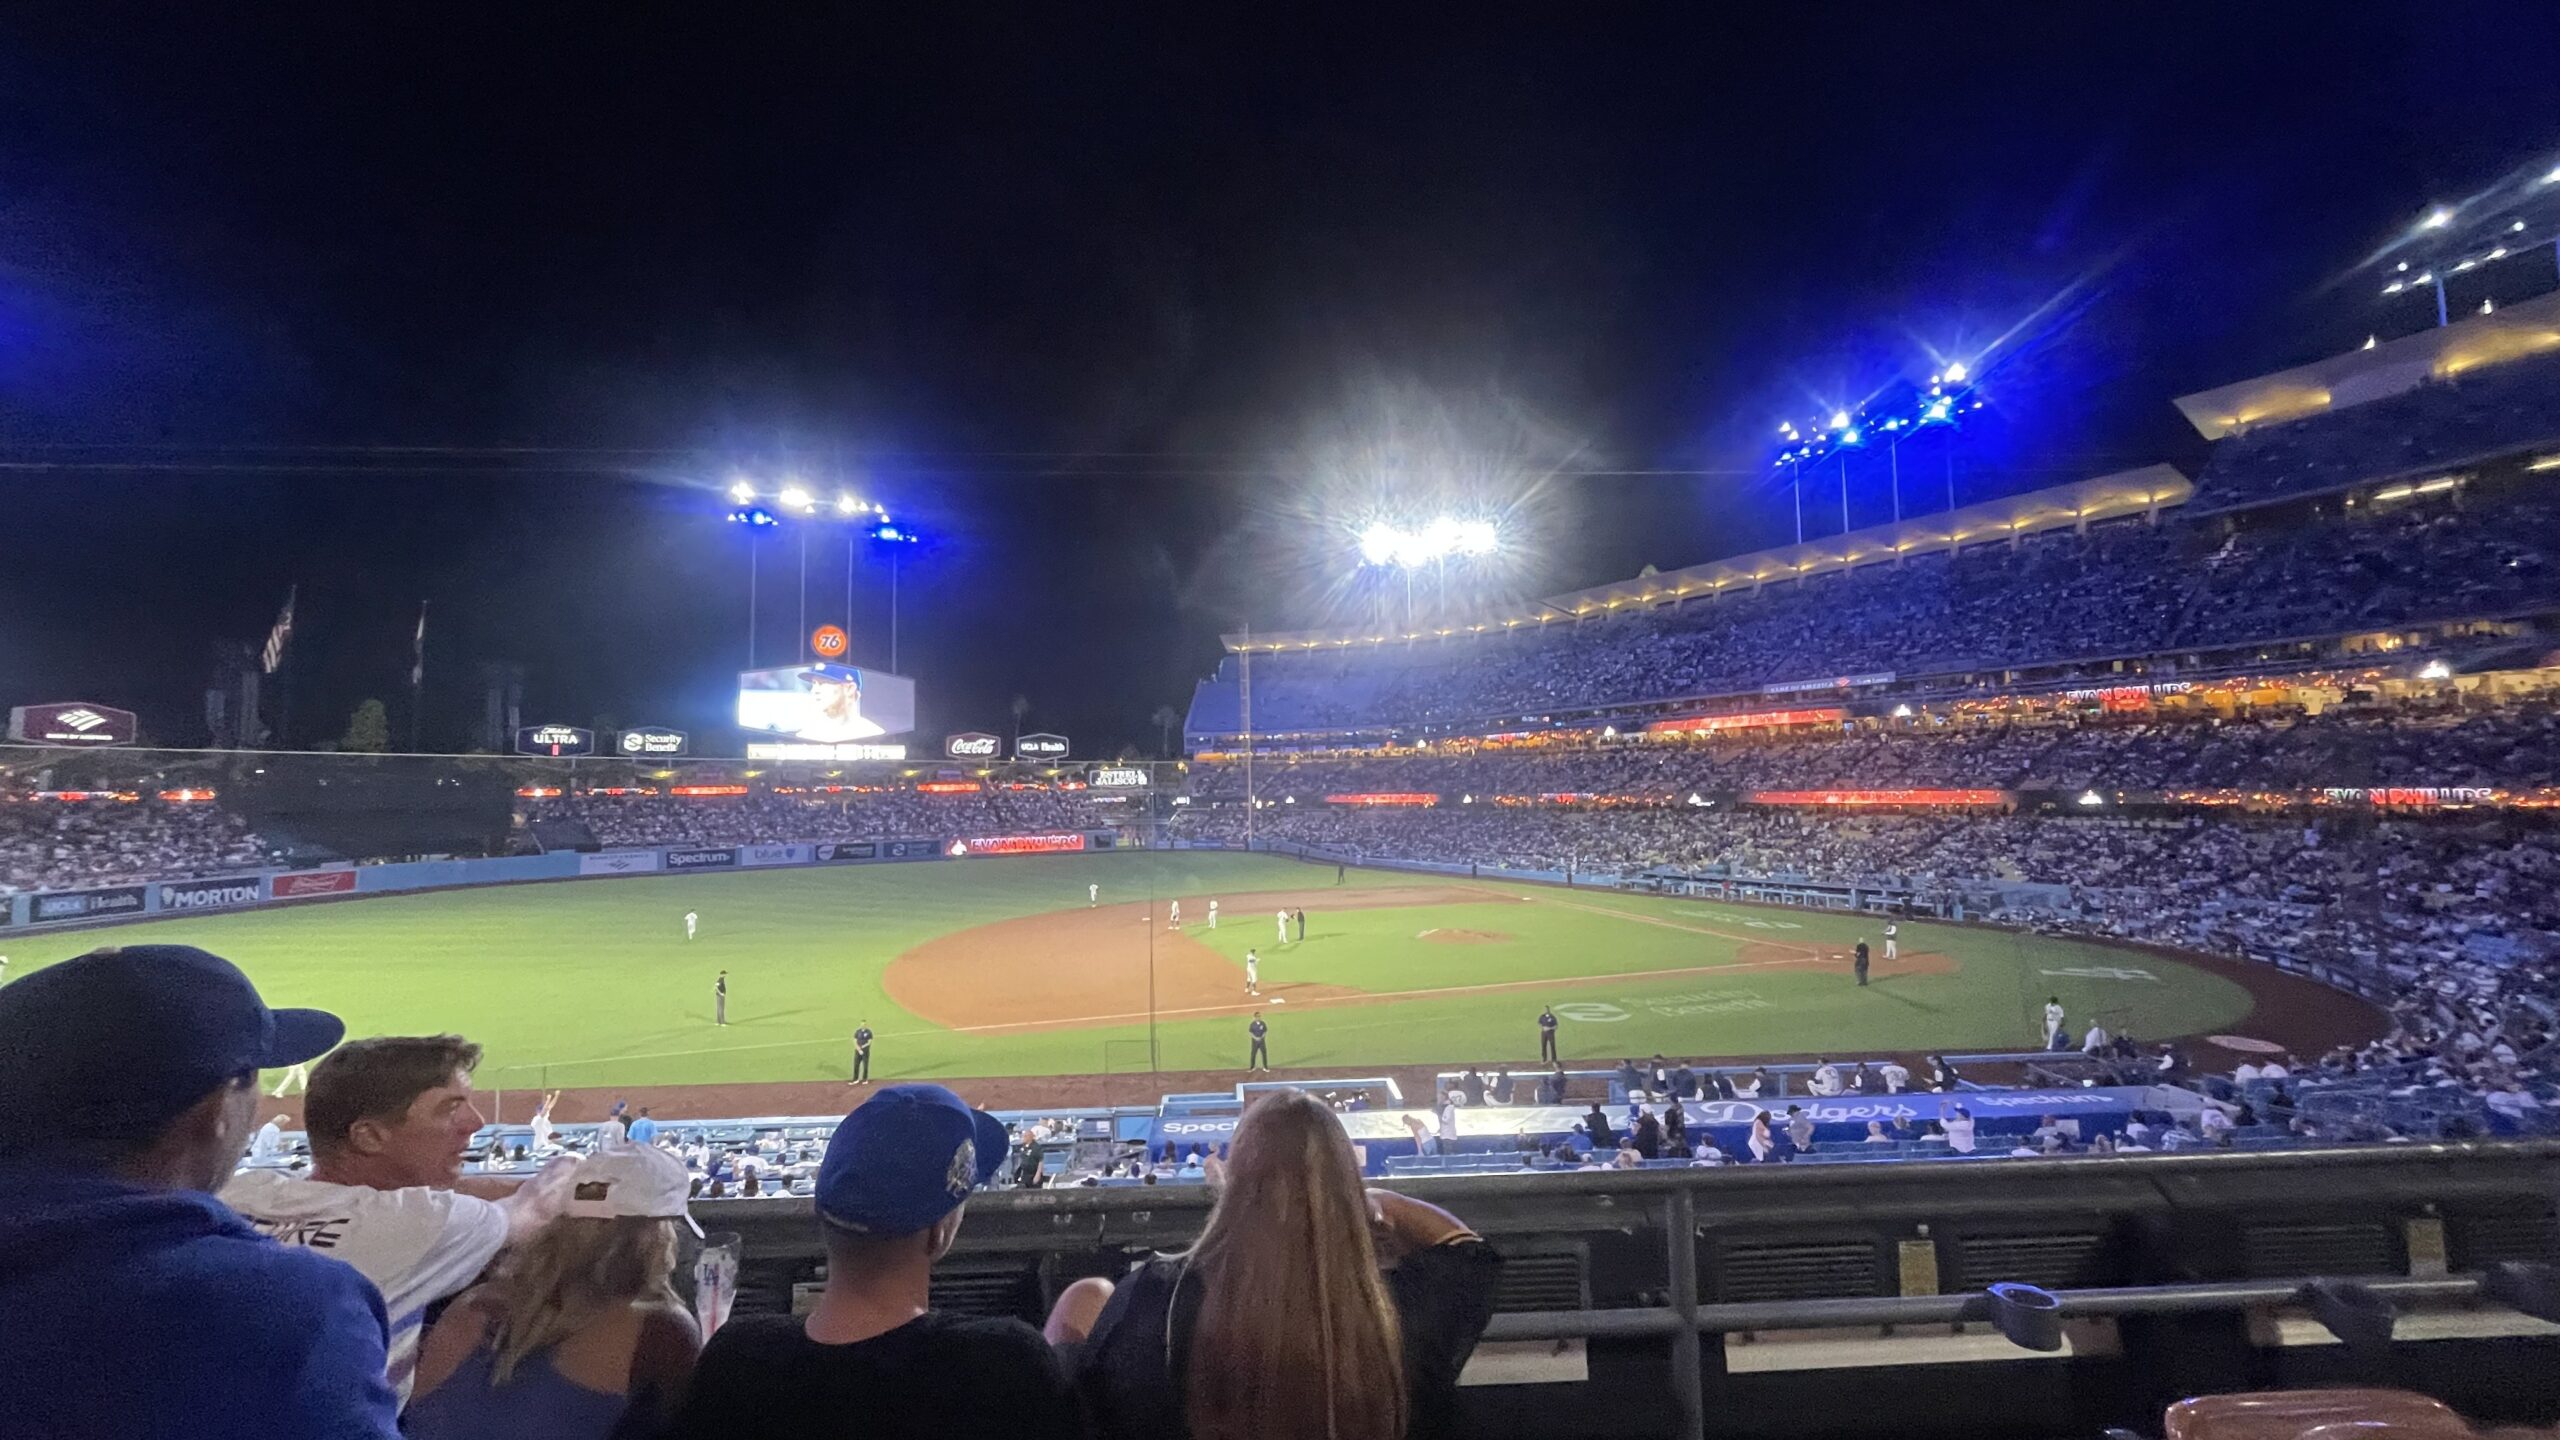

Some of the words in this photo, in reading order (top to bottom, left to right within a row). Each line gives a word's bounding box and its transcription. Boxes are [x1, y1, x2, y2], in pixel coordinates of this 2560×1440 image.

[821, 635, 841, 649] 76
[533, 734, 578, 744] ULTRA
[645, 734, 682, 745] Security
[645, 743, 678, 752] Benefit
[1041, 742, 1065, 751] Health
[1095, 777, 1137, 786] JALISCO
[669, 852, 726, 866] Spectrum
[174, 885, 260, 907] MORTON
[1975, 1095, 2115, 1107] Spectrum
[1699, 1100, 1918, 1123] Dodgers
